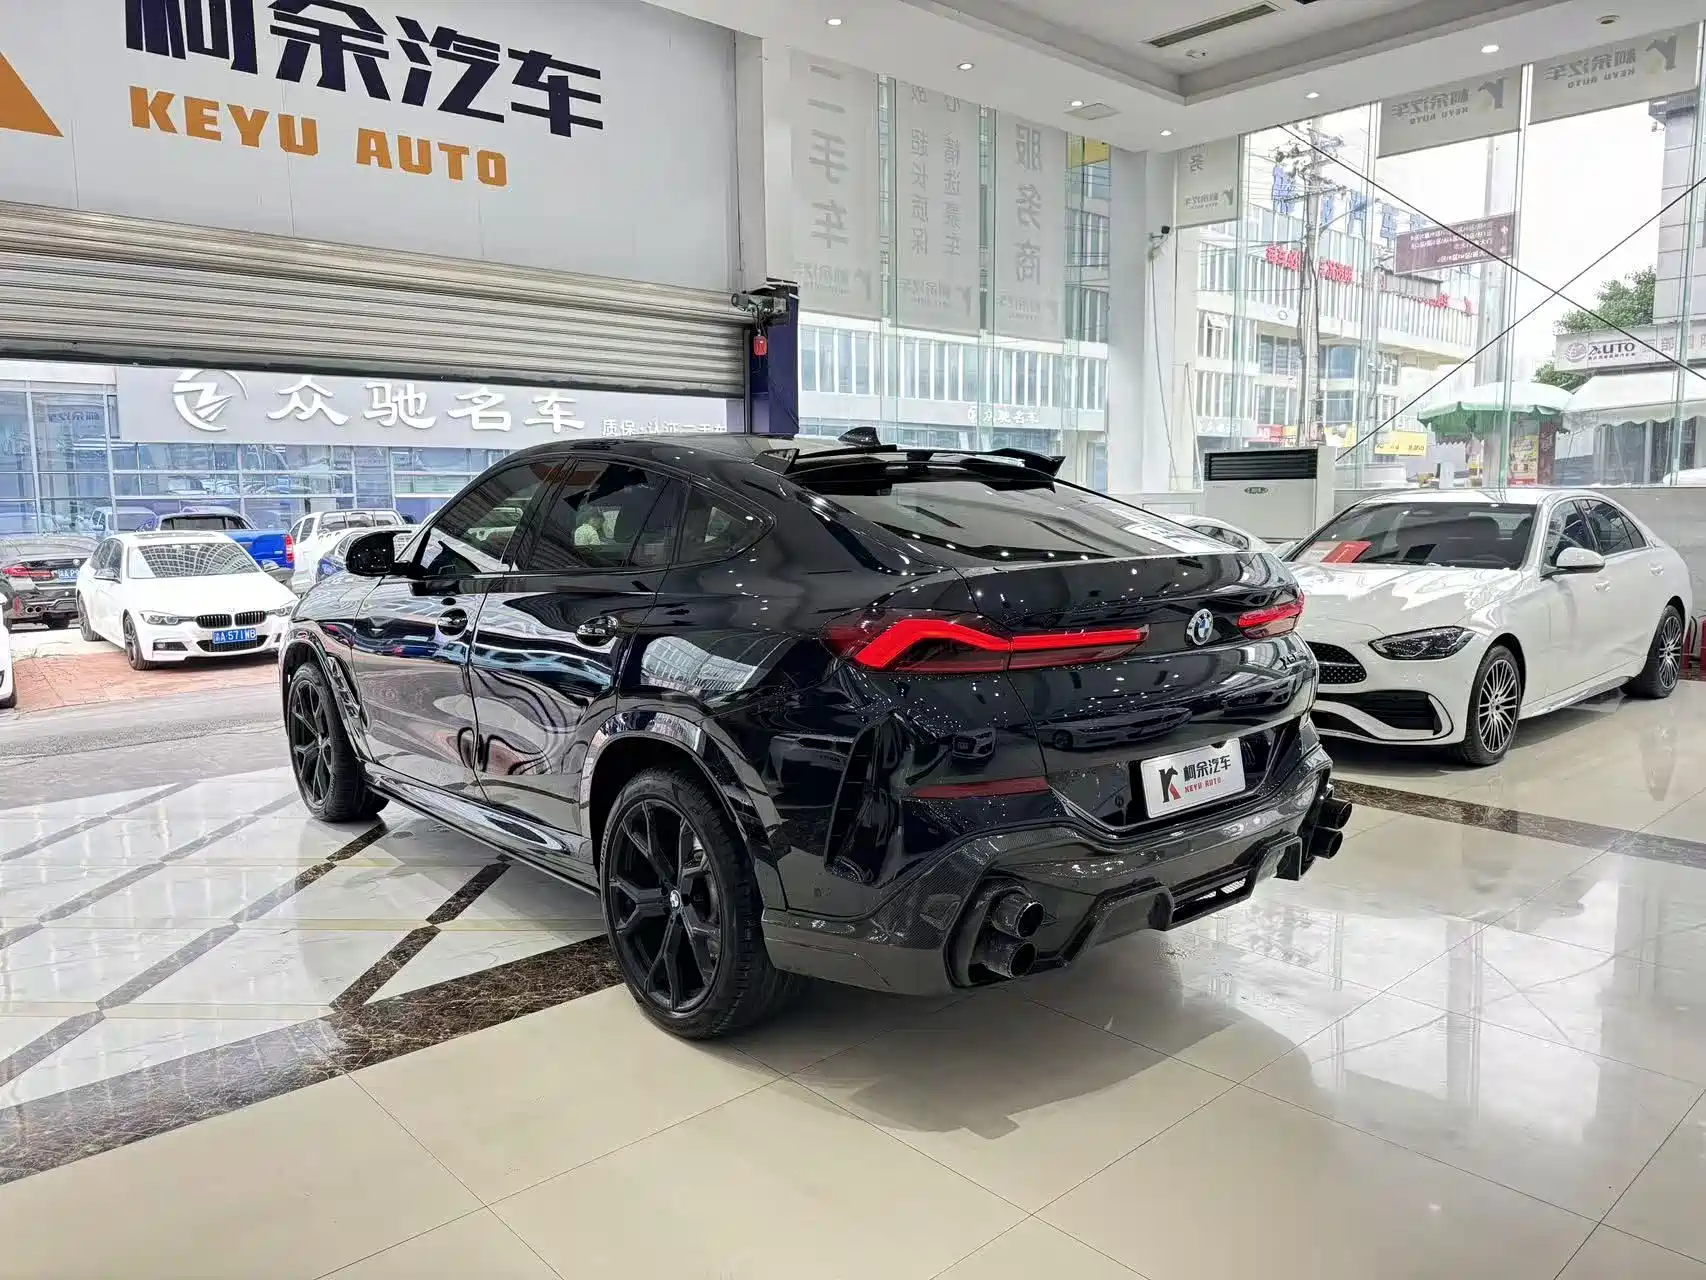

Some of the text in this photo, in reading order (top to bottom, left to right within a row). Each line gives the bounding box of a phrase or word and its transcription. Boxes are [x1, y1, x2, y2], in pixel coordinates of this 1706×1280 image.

[130, 86, 507, 187] KEYU AUTO
[267, 376, 586, 436] 众驰名车
[1183, 755, 1231, 782] 柯余汽车
[1184, 782, 1202, 793] KEYU
